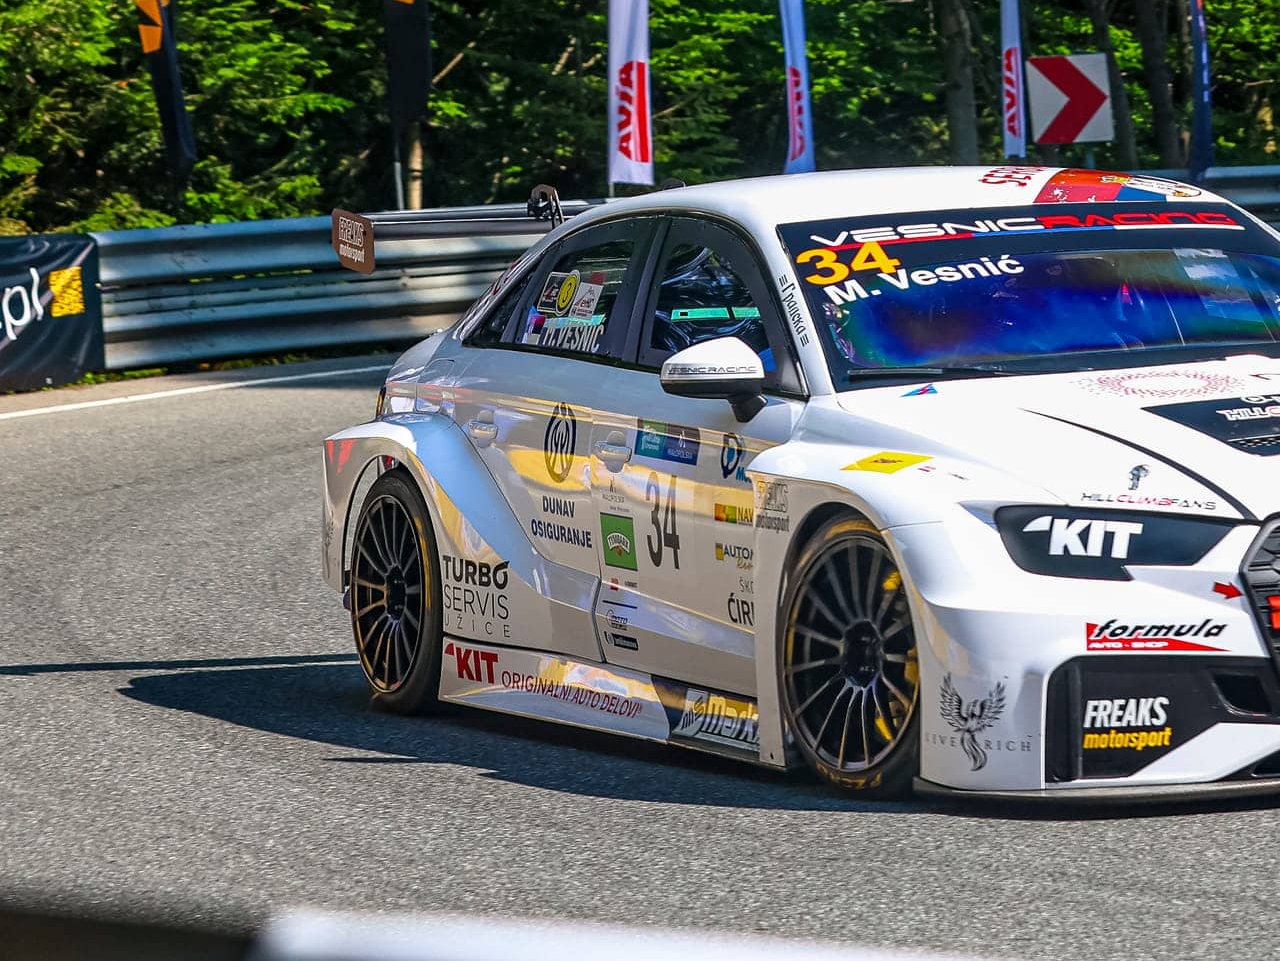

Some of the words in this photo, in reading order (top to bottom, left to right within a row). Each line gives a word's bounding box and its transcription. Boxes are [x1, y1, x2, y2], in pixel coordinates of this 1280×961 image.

[616, 59, 635, 160] AVIA
[339, 216, 364, 247] FREAKS
[796, 241, 901, 286] 34
[823, 279, 882, 305] M.
[877, 254, 1024, 290] Vesnić
[543, 496, 575, 518] DUNAV
[1081, 492, 1216, 511] HILLCLIMBFANS
[531, 519, 592, 548] OSIGURANJE
[645, 471, 680, 570] 34
[1049, 518, 1144, 559] KIT
[443, 555, 510, 590] TURBO
[444, 584, 509, 620] SERVIS
[1094, 618, 1228, 639] formula
[455, 644, 498, 684] KIT
[501, 670, 572, 700] ORIGINALNI
[571, 686, 601, 708] AUTO
[1083, 696, 1170, 728] FREAKS
[984, 739, 1032, 752] RICH
[1082, 726, 1172, 751] motorsport
